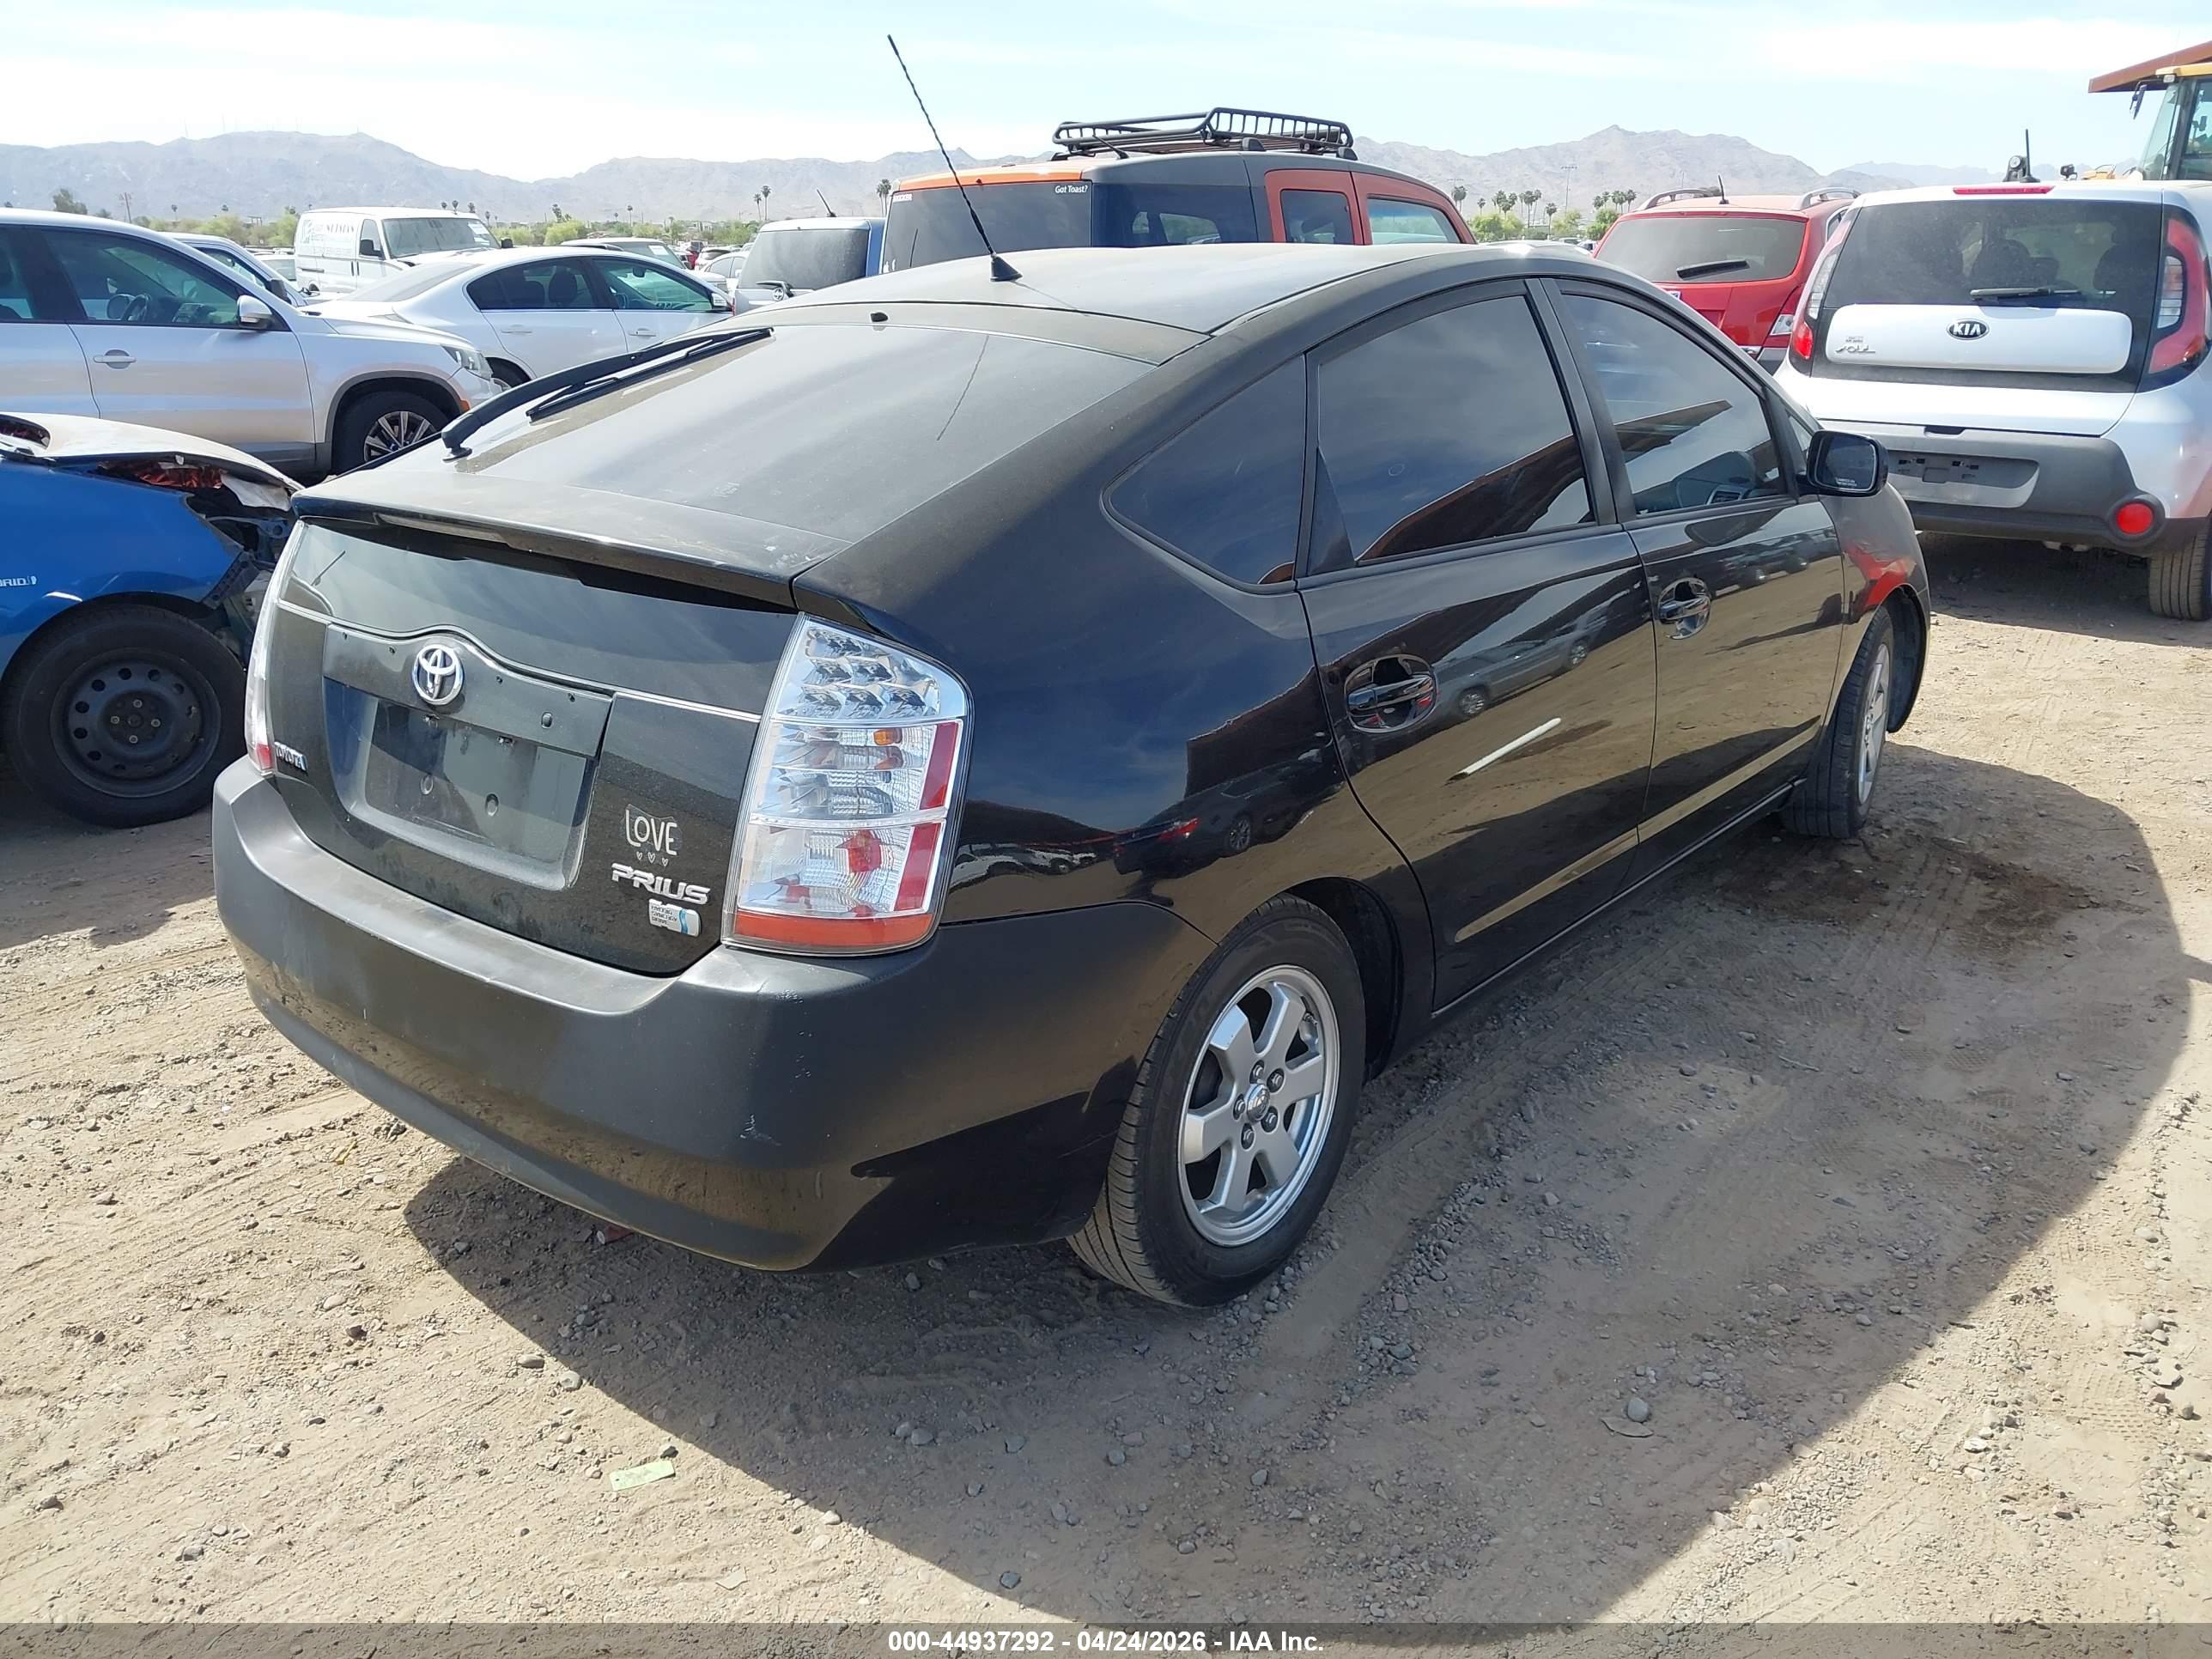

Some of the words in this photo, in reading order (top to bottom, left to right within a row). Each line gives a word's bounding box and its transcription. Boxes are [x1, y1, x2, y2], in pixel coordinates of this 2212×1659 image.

[1055, 185, 1067, 193] Got
[1067, 185, 1089, 193] Toast?
[1953, 323, 1981, 336] KIA
[0, 577, 27, 587] RID
[274, 741, 307, 771] TOYOTA
[625, 809, 678, 856] LOVE
[611, 862, 711, 905] PRIUS
